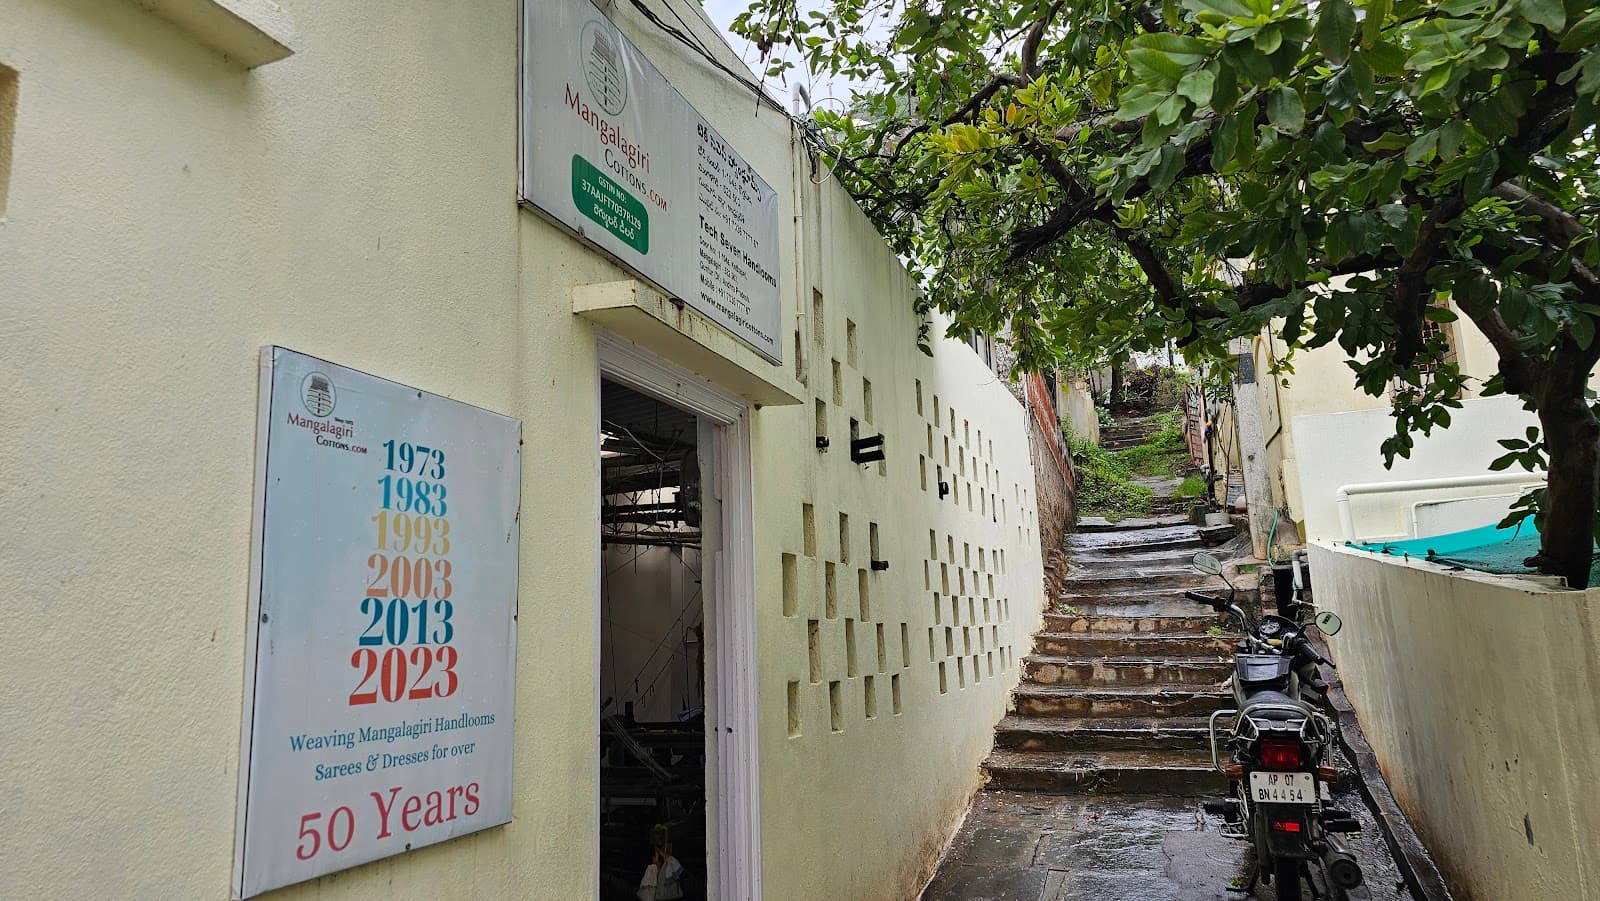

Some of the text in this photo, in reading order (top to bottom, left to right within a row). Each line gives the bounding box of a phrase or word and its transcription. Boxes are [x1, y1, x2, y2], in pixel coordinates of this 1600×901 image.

[565, 83, 650, 174] Mangalagiri
[599, 176, 616, 195] GSTIN
[699, 213, 718, 240] Tech
[720, 232, 741, 257] Seven
[743, 250, 777, 288] Handlooms
[287, 411, 354, 440] Mangalagiri
[383, 439, 445, 480] 1973
[377, 474, 447, 517] 1983
[371, 510, 450, 555] 1993
[366, 553, 452, 599] 2003
[359, 597, 454, 646] 2013
[349, 646, 458, 706] 2023
[289, 712, 495, 753] Weaving Mangalagiri Handlooms
[314, 742, 476, 781] Sarees & Dresses for over
[1268, 774, 1294, 786] AP 07
[296, 781, 480, 861] 50 Years
